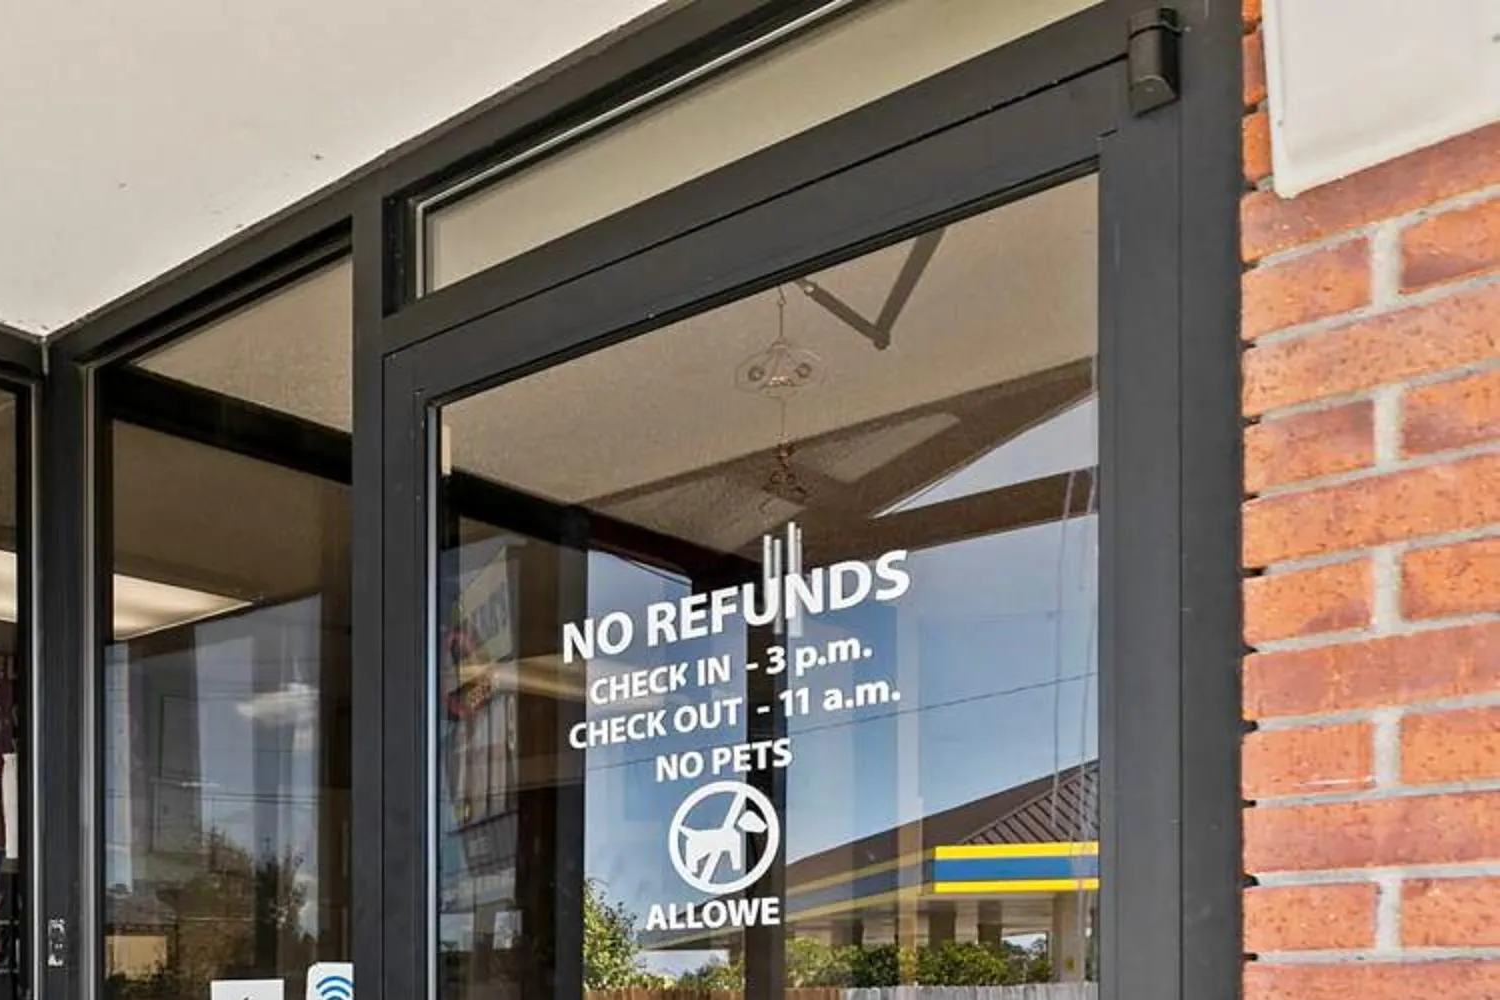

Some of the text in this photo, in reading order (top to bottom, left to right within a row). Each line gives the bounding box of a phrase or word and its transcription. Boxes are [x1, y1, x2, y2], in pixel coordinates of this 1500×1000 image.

[563, 549, 911, 663] NO REFUNDS
[589, 662, 688, 705] CHECK
[697, 654, 731, 686] IN
[766, 646, 786, 675] 3
[796, 636, 873, 677] p.m.
[569, 708, 667, 749] CHECK
[674, 697, 743, 734] OUT
[779, 686, 810, 719] 11
[821, 678, 901, 712] a.m.
[655, 737, 793, 782] NO PETS
[645, 896, 781, 932] ALLOWE
